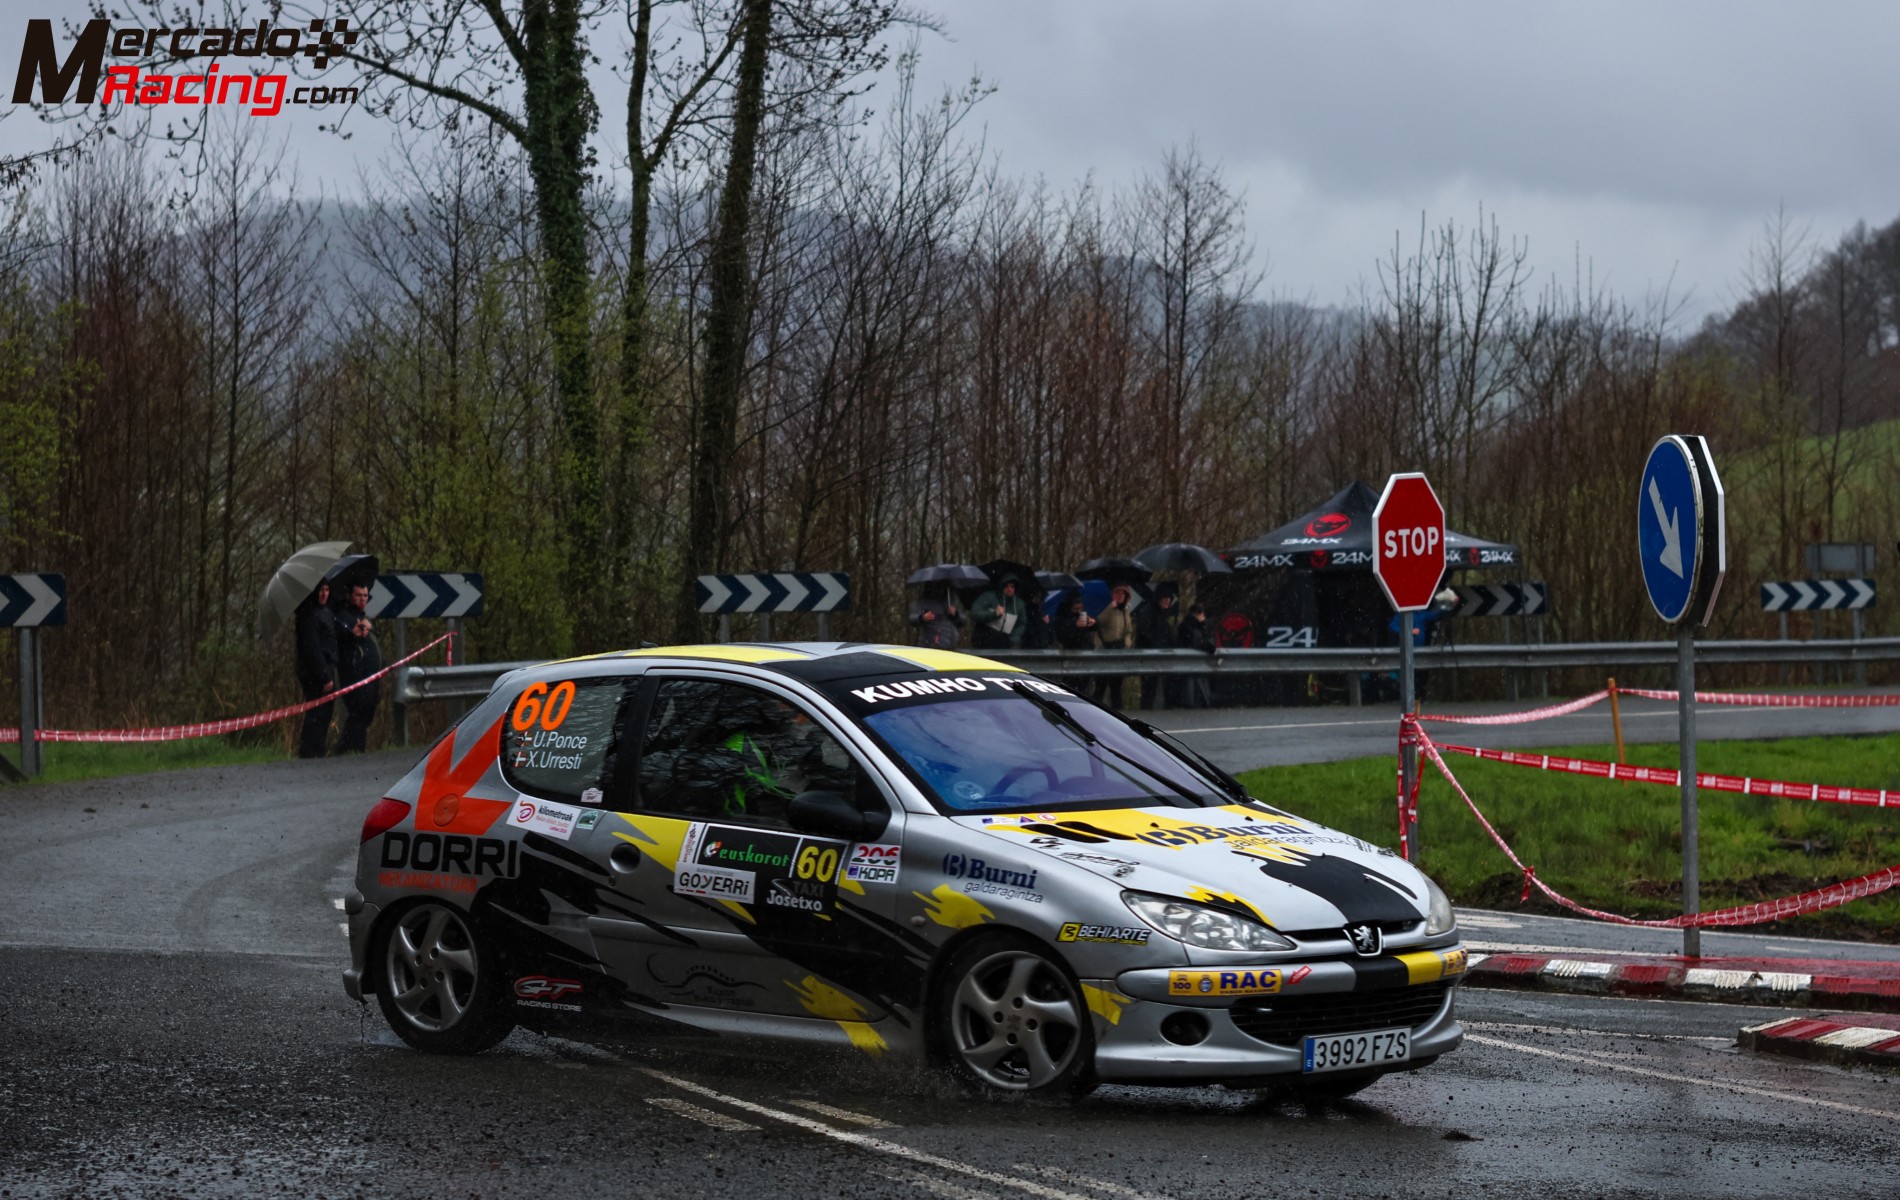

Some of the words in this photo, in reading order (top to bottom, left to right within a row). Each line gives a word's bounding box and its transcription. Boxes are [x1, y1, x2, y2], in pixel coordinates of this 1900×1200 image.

[1385, 526, 1439, 558] STOP
[1234, 554, 1293, 568] 24MX
[1331, 551, 1373, 564] 24M
[1480, 550, 1514, 563] 24MX
[851, 677, 987, 704] KUMHO
[512, 681, 576, 731] 60
[532, 731, 588, 750] U.Ponce
[526, 751, 583, 770] X.Urresti
[1180, 821, 1314, 840] Burni
[380, 831, 518, 878] DORRI
[852, 845, 901, 865] 206
[797, 846, 839, 883] 60
[967, 858, 1038, 889] Burni
[858, 867, 896, 882] KOPA
[791, 880, 825, 898] TAXI
[963, 882, 1044, 904] galdaragintza
[766, 889, 824, 912] Josetxo
[1078, 925, 1152, 941] BEHIARTE
[1220, 971, 1277, 989] RAC
[516, 999, 551, 1009] RACING
[552, 1002, 582, 1012] STORE
[1316, 1037, 1368, 1068] 3992
[1372, 1031, 1407, 1062] FZS
